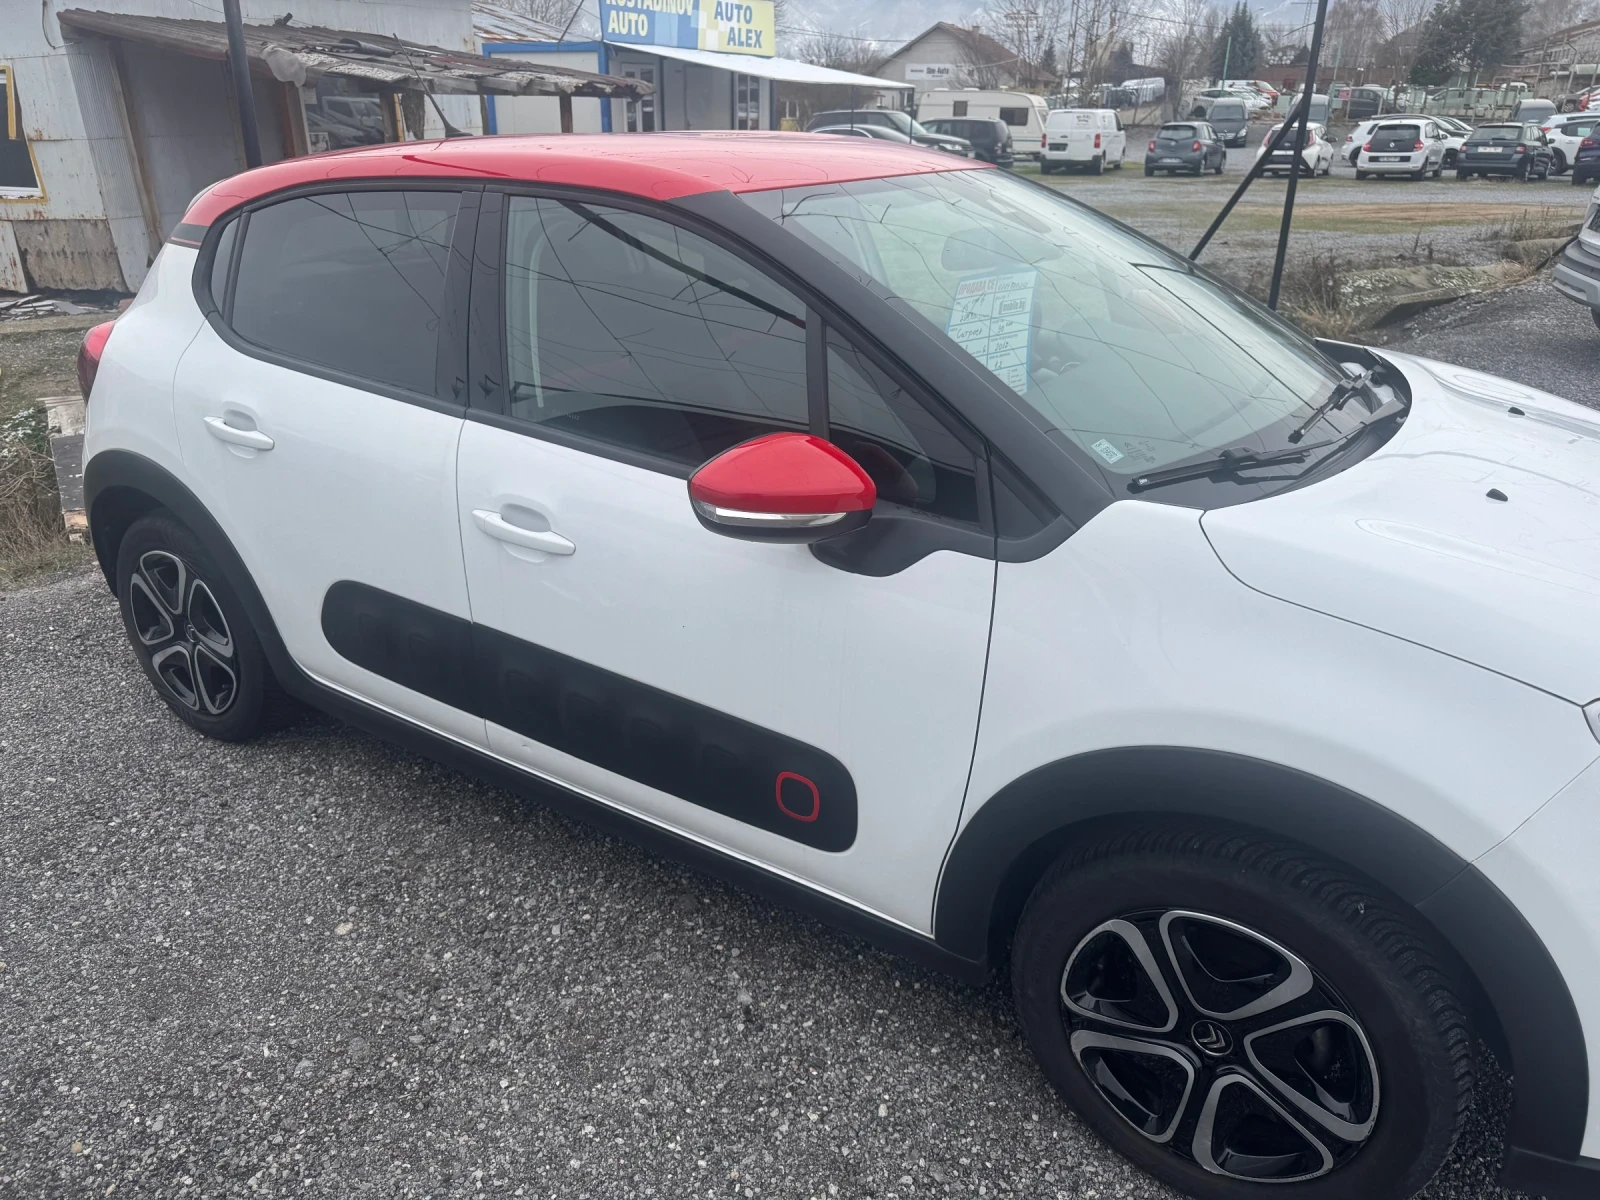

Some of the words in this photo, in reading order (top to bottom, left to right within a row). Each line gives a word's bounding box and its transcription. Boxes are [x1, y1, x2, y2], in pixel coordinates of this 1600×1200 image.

[606, 0, 694, 16] ADINOV
[714, 1, 753, 25] AUTO
[607, 9, 648, 37] AUTO
[727, 26, 763, 49] ALEX
[987, 278, 996, 291] СЕ
